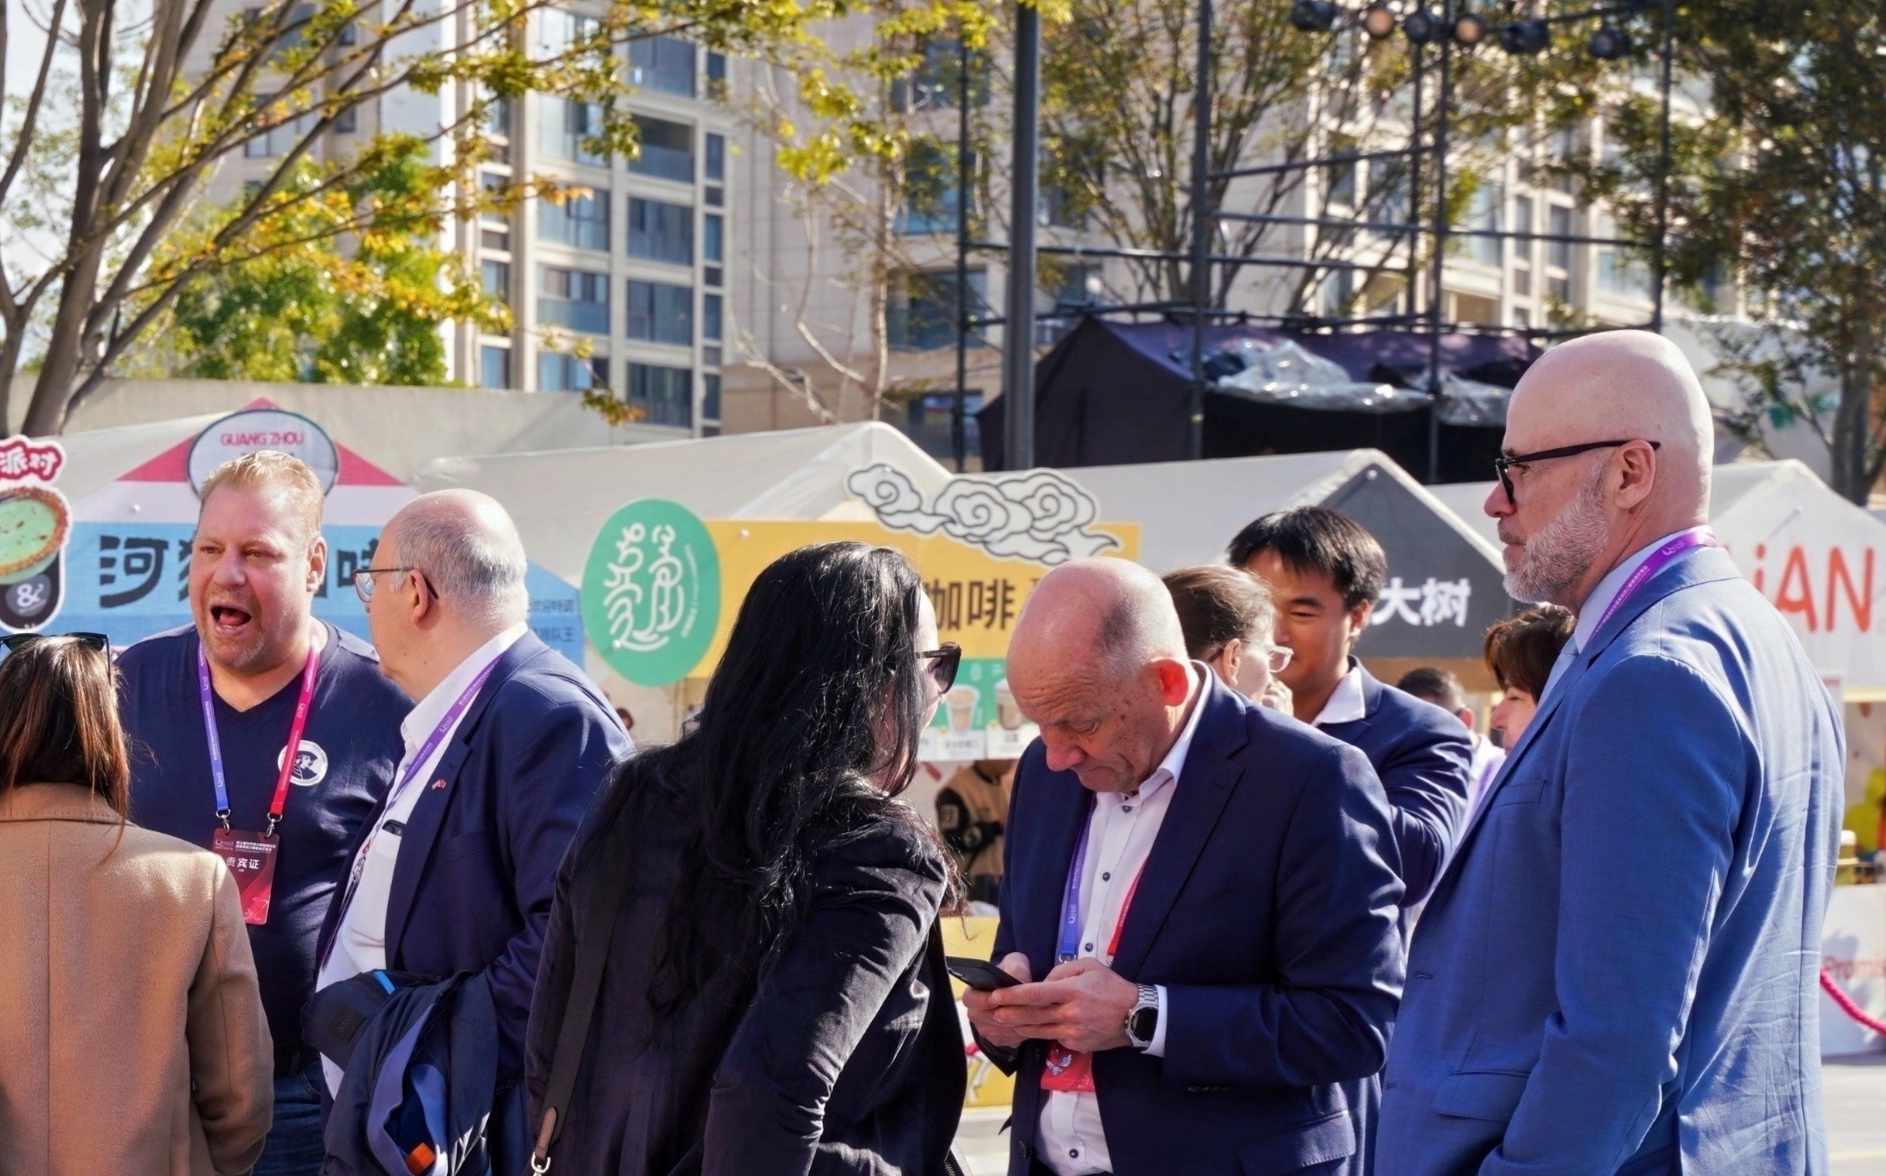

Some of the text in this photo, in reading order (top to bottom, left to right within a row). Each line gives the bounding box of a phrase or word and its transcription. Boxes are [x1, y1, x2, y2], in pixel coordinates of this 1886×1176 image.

[220, 431, 305, 446] GUANG ZHOU
[1371, 576, 1472, 628] 大树
